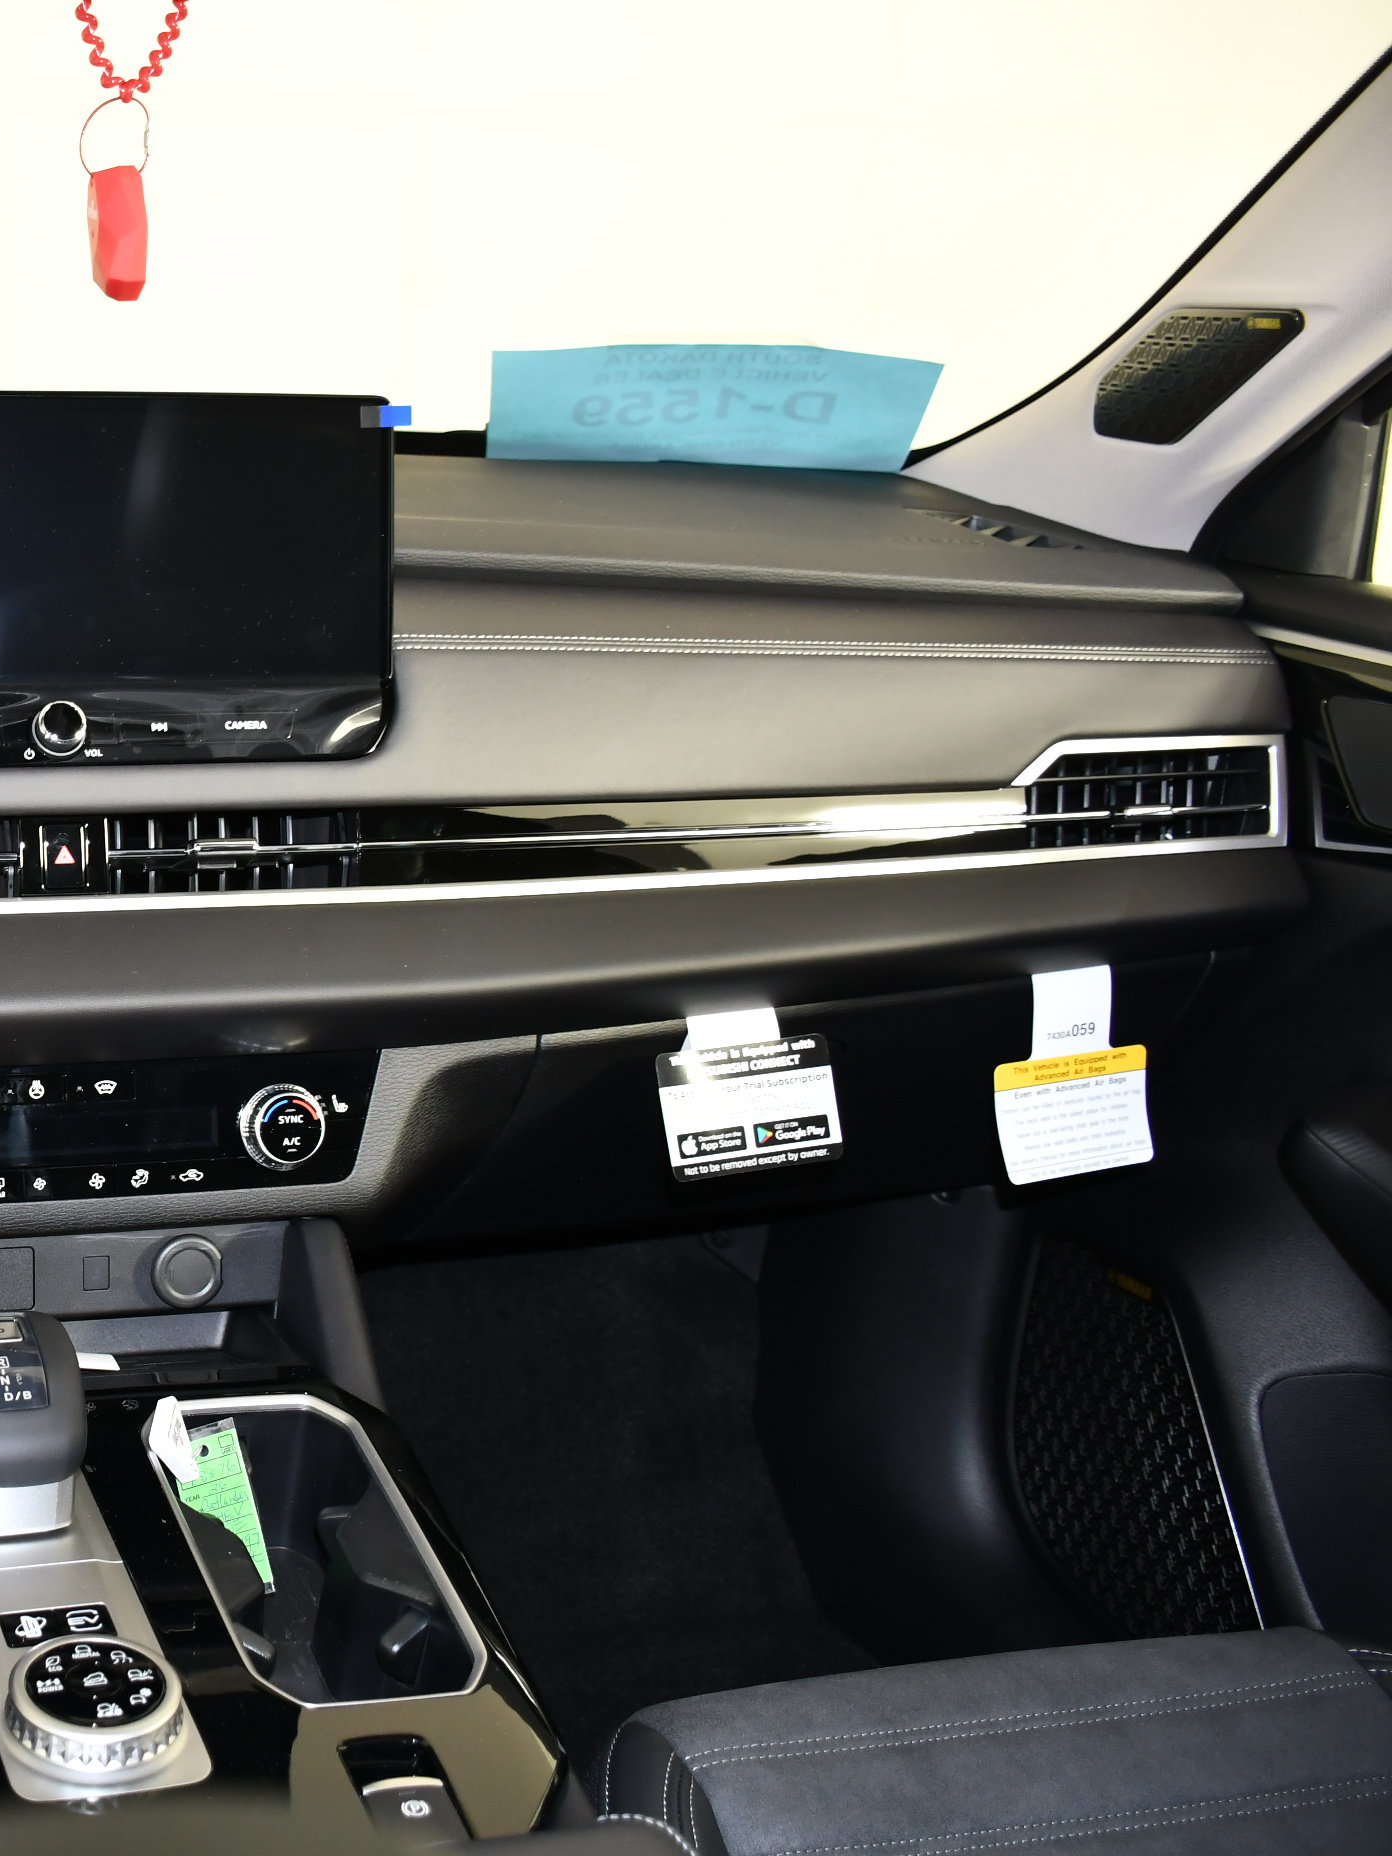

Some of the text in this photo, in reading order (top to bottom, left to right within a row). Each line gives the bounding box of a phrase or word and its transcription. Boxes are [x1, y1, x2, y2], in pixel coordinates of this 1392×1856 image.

[224, 720, 268, 730] CAMERA
[84, 748, 104, 758] VOL
[749, 1054, 801, 1071] CONNECT
[1013, 1066, 1029, 1075] This
[1033, 1061, 1060, 1072] Vehicle
[1074, 1054, 1109, 1067] Equipped
[1112, 1052, 1128, 1061] with
[1034, 1065, 1107, 1082] Advanced Air Bags
[743, 1078, 765, 1091] Trial
[766, 1072, 829, 1088] Subscription
[1014, 1075, 1127, 1100] Even with Advanced Air Bags
[277, 1114, 305, 1125] SYNC
[775, 1126, 826, 1141] Google Play
[282, 1136, 302, 1147] A/C
[700, 1138, 743, 1152] App Store
[683, 1166, 699, 1176] Not
[699, 1165, 709, 1174] to
[709, 1163, 721, 1172] be
[721, 1156, 758, 1170] removed
[758, 1154, 787, 1167] except
[787, 1150, 799, 1162] by
[0, 1375, 11, 1386] N
[185, 1493, 201, 1503] YEAR
[48, 1665, 64, 1673] ECO
[37, 1683, 64, 1694] POWER
